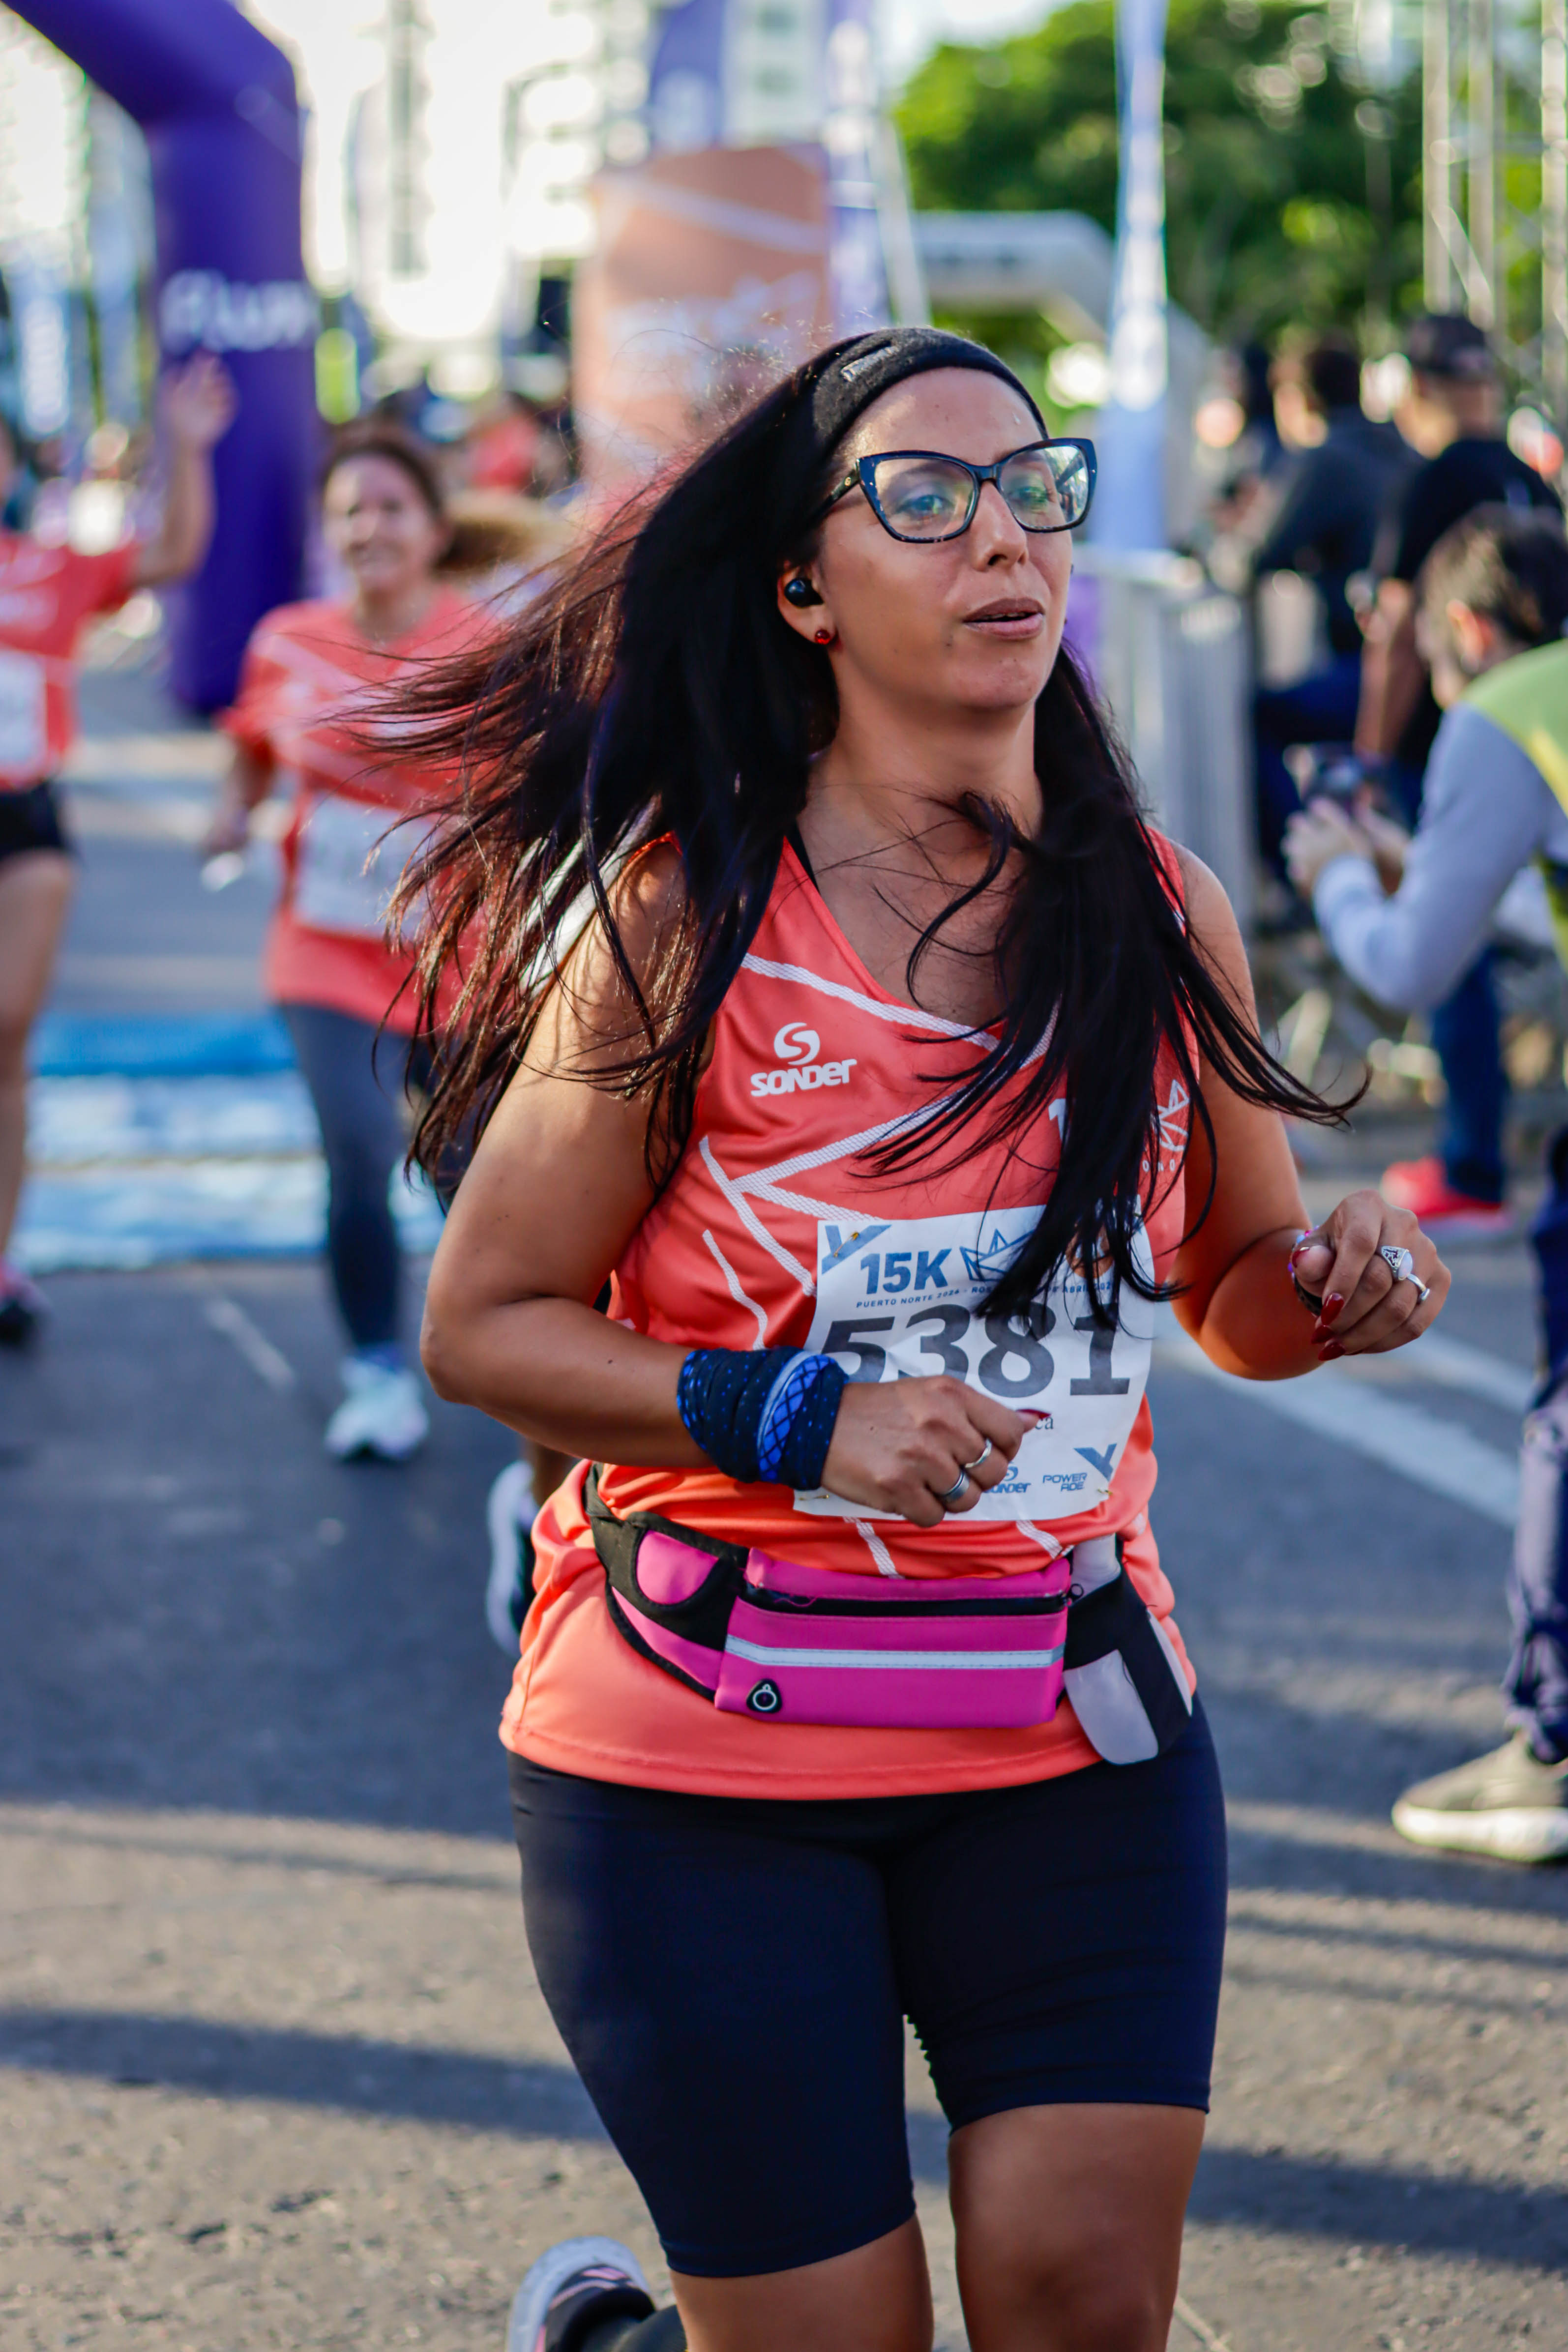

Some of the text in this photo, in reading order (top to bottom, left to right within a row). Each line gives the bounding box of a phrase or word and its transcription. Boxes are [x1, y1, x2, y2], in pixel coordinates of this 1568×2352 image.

[860, 1248, 952, 1294] 15K
[856, 1298, 897, 1308] PUERTO
[901, 1294, 933, 1304] NORTE
[821, 1303, 1130, 1398] 5381
[1042, 1472, 1088, 1483] POWER
[1061, 1482, 1085, 1492] ADE
